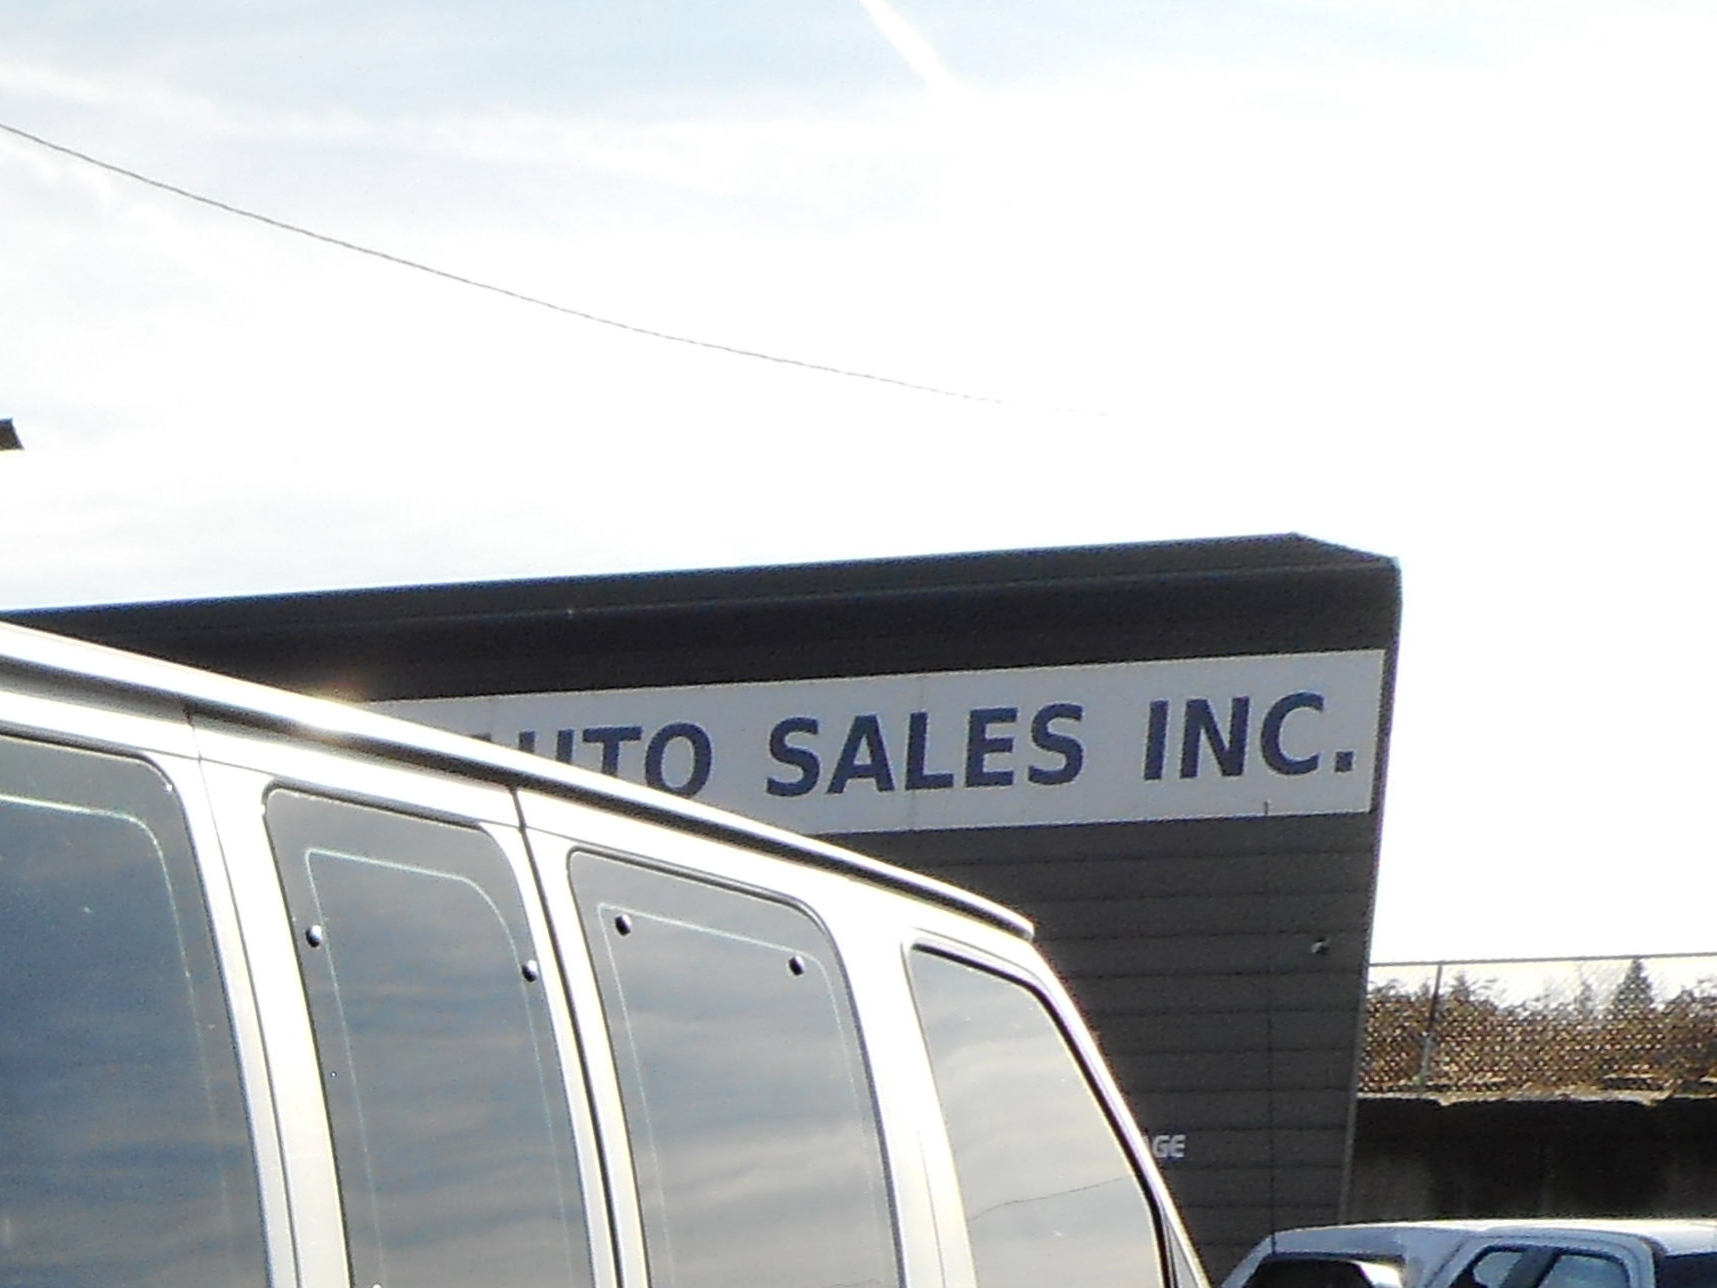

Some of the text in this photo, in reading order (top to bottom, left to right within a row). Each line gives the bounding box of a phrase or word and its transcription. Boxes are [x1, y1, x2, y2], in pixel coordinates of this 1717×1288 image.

[468, 691, 1356, 799] TO SALES INC.
[1145, 1133, 1186, 1158] GE
